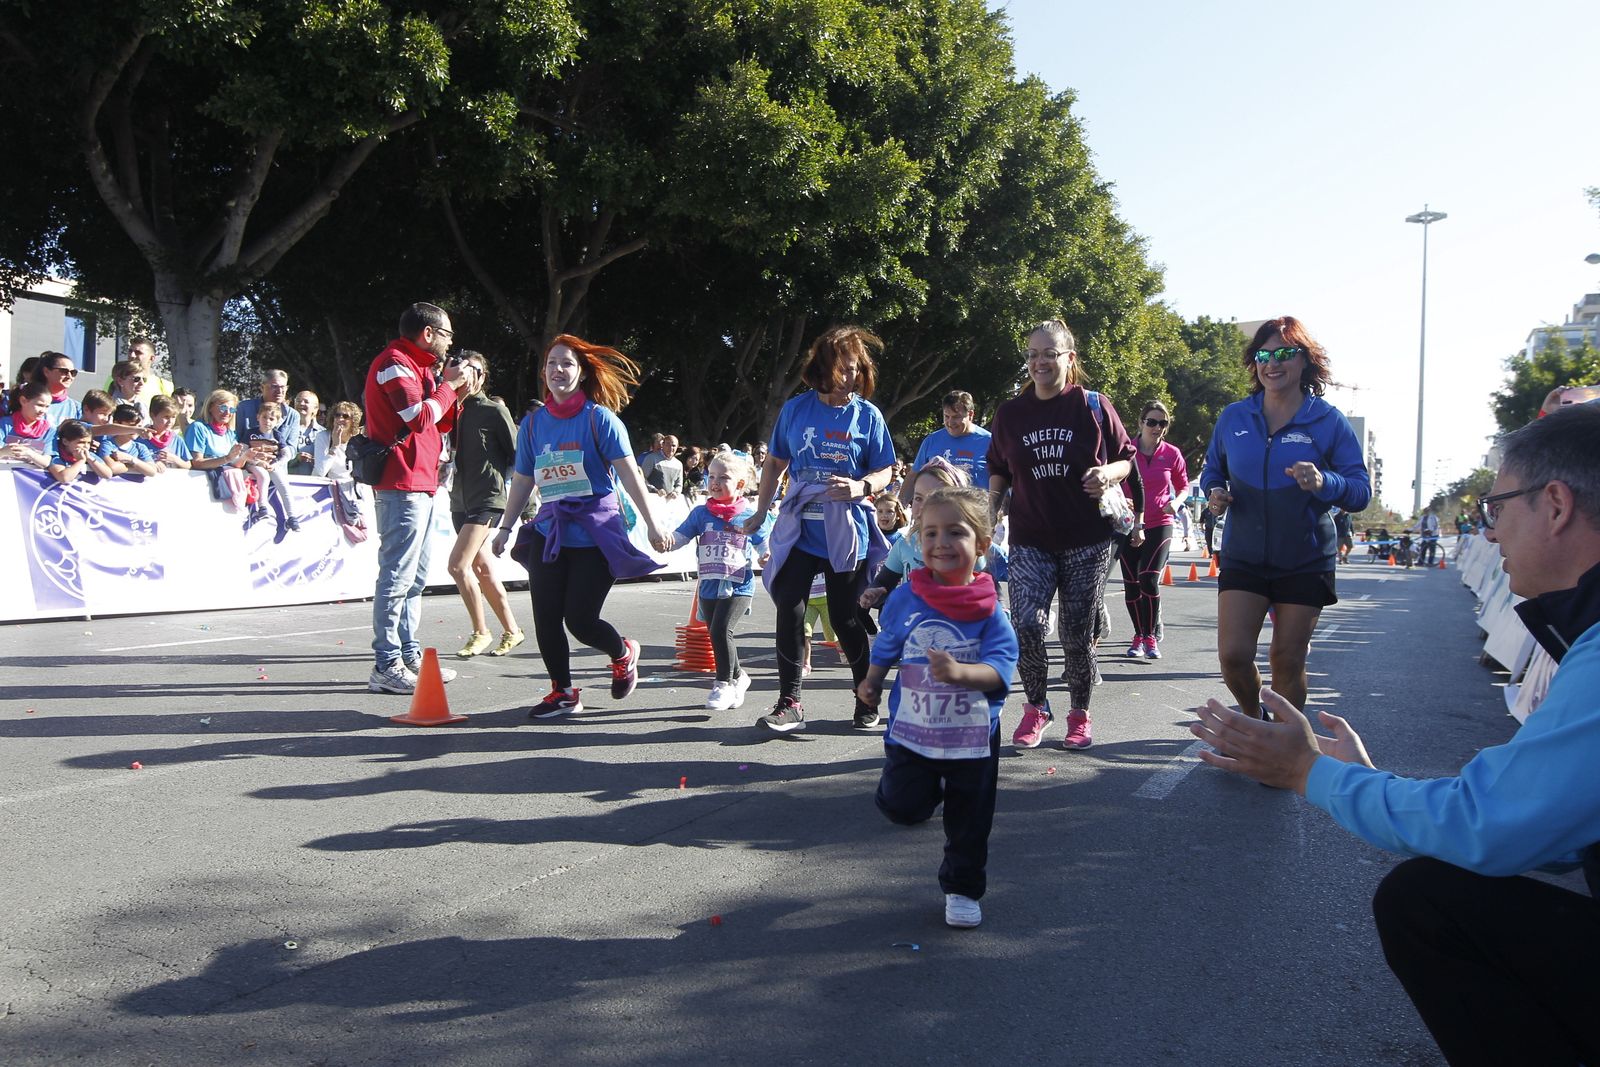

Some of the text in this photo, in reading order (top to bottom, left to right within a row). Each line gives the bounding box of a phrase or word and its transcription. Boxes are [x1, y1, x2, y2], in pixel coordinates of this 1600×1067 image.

[1022, 428, 1073, 446] SWEETER
[821, 441, 850, 450] CARRERA
[1032, 444, 1064, 460] THAN
[542, 464, 577, 480] 2163
[1031, 463, 1070, 480] HONEY
[911, 691, 971, 716] 3175
